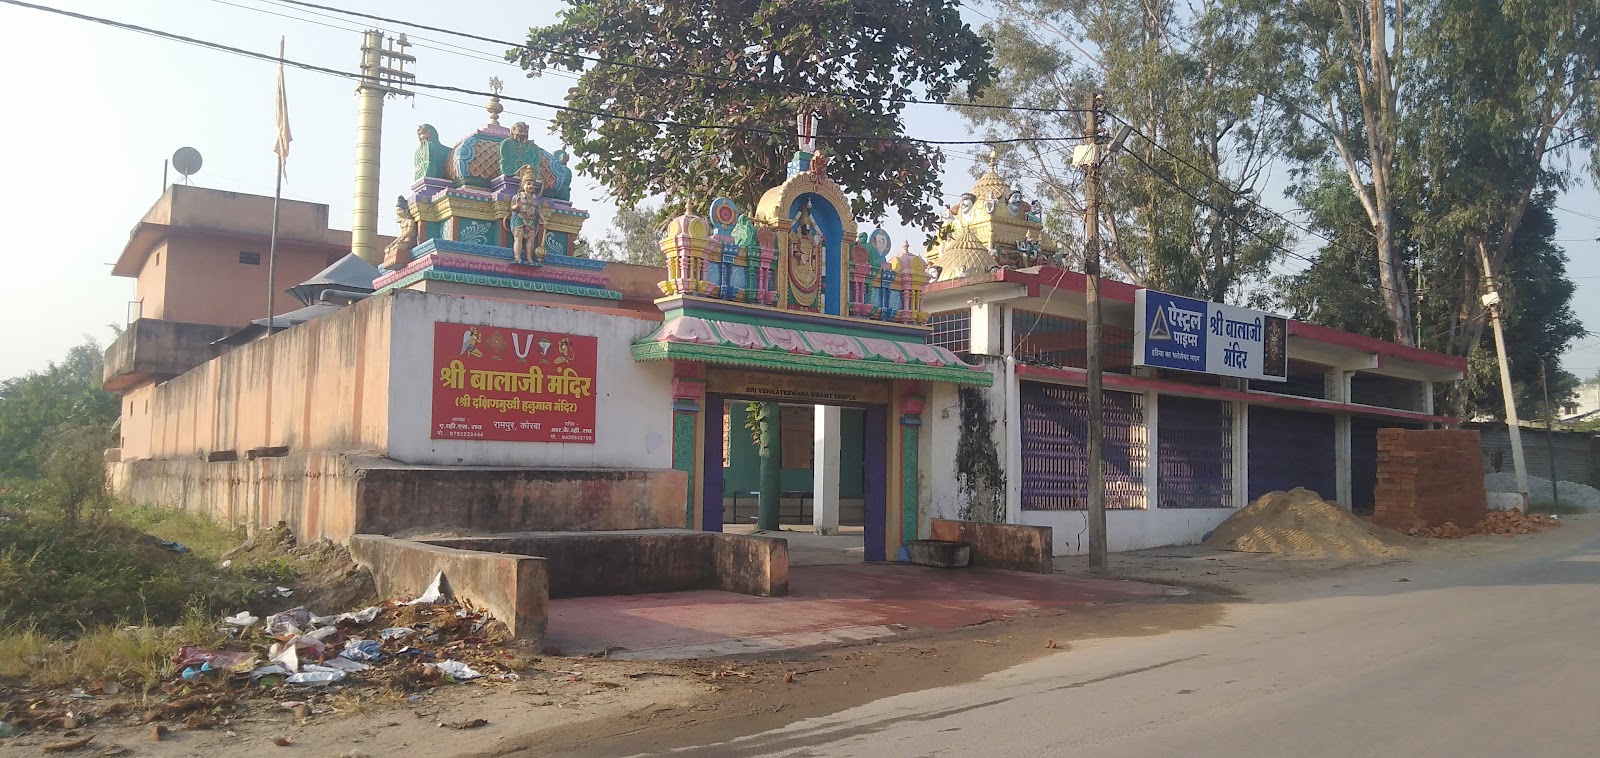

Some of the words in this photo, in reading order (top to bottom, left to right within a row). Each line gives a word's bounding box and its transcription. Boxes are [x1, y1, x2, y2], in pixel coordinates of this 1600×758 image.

[1210, 310, 1224, 337] श्री
[1226, 316, 1262, 342] बालाजी
[1172, 331, 1198, 348] पाइप्स
[1223, 342, 1248, 369] मंदिर
[440, 359, 466, 389] श्री
[470, 365, 543, 394] बालाजी
[547, 366, 592, 398] मंदिर
[455, 393, 470, 408] (श्री
[472, 395, 520, 413] दक्षिणमुखी
[522, 400, 552, 414] हनुमान
[554, 399, 578, 413] मंदिर)
[758, 387, 810, 398] VENKATESWARA
[834, 393, 857, 401] TEMPLE
[493, 420, 517, 432] रामपुर,
